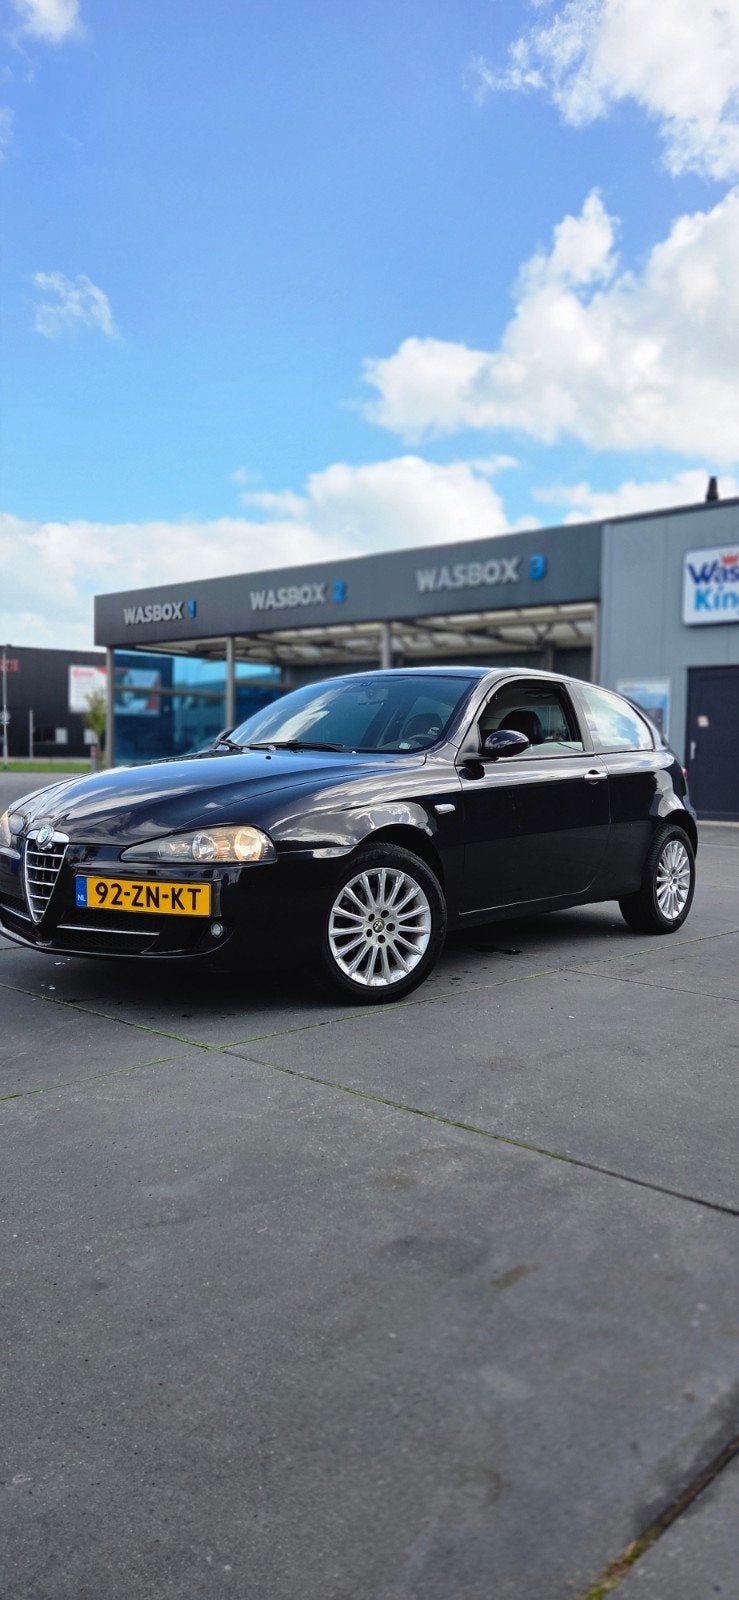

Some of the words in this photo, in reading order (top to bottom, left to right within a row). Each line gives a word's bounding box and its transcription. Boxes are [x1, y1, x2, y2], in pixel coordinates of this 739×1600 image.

[416, 556, 519, 592] WASBOX
[528, 554, 545, 580] 3
[250, 582, 326, 611] WASBOX
[332, 580, 346, 602] 2
[694, 585, 739, 616] Kin
[123, 601, 183, 625] WASBOX
[187, 600, 196, 619] 1
[77, 894, 86, 902] NL
[95, 882, 201, 910] 92-ZN-KT
